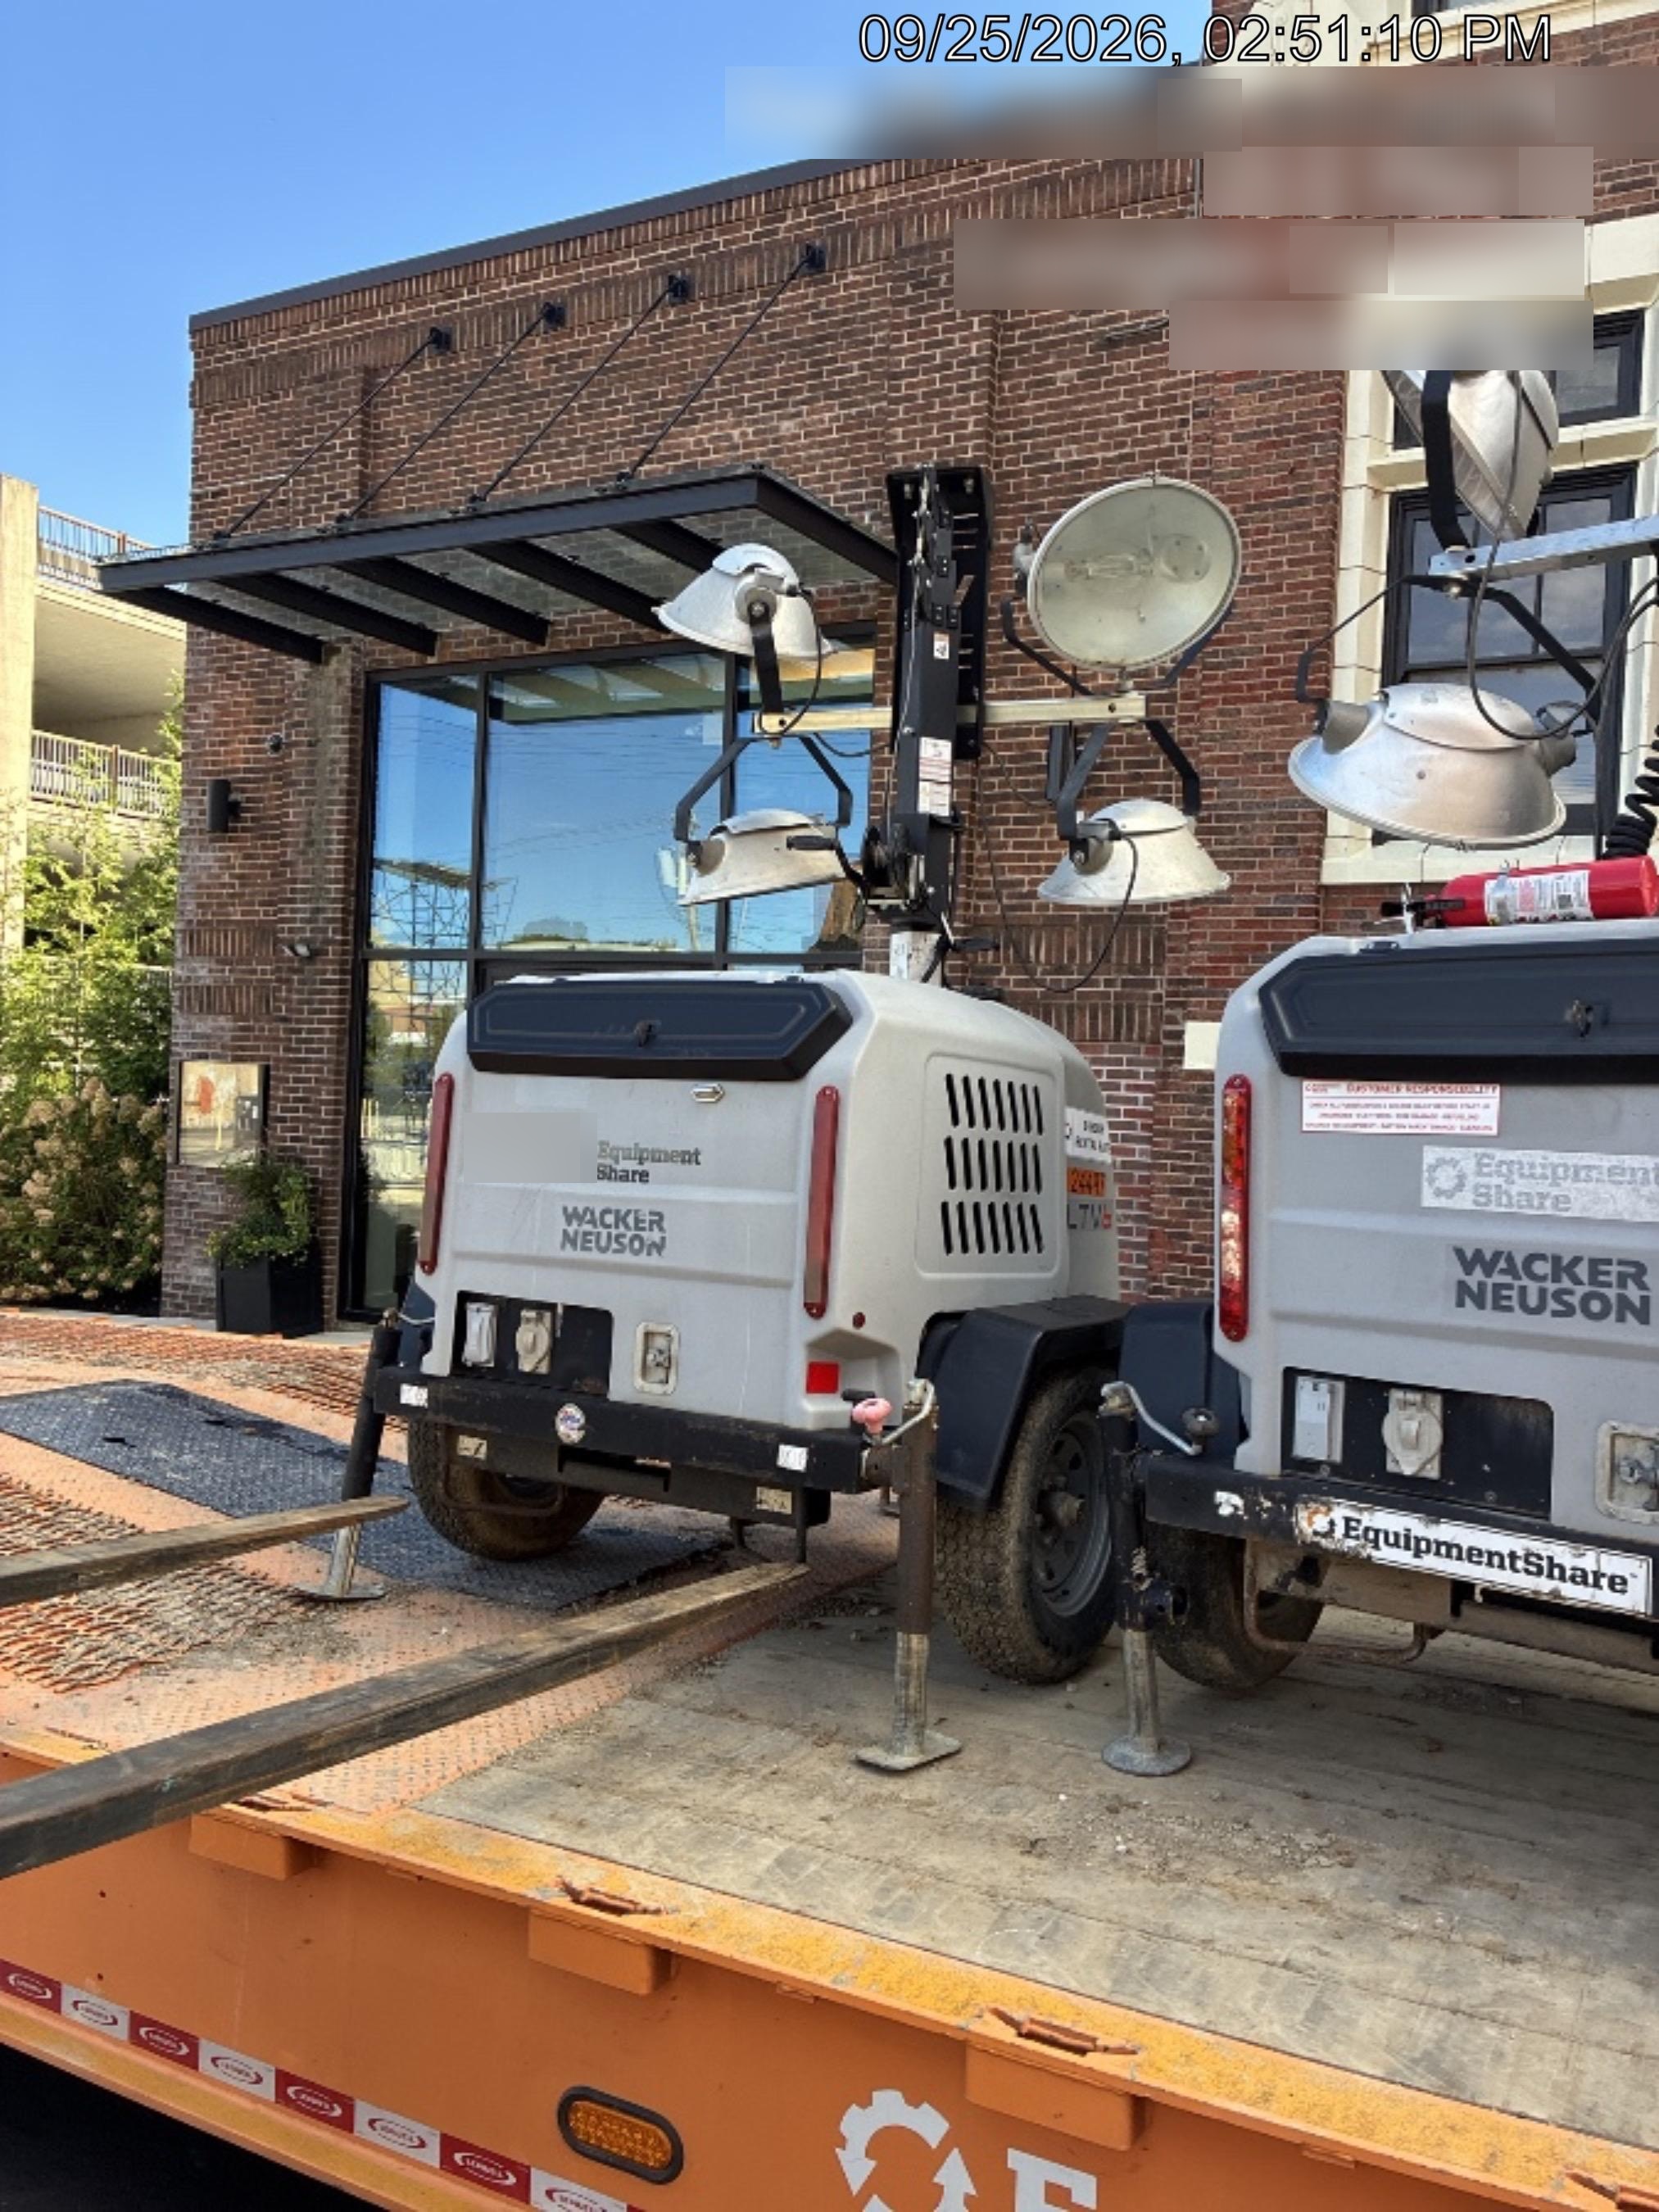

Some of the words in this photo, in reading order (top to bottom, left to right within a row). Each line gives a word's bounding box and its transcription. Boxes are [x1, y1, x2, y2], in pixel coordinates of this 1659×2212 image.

[597, 1140, 701, 1166] Equipment
[596, 1163, 650, 1184] Share
[1472, 1182, 1572, 1213] Share
[562, 1205, 667, 1233] WACKER
[560, 1229, 667, 1258] NEUSON
[1453, 1246, 1652, 1291] WACKER
[1454, 1280, 1651, 1325] NEUSON
[1343, 1516, 1629, 1594] EquipmentShare
